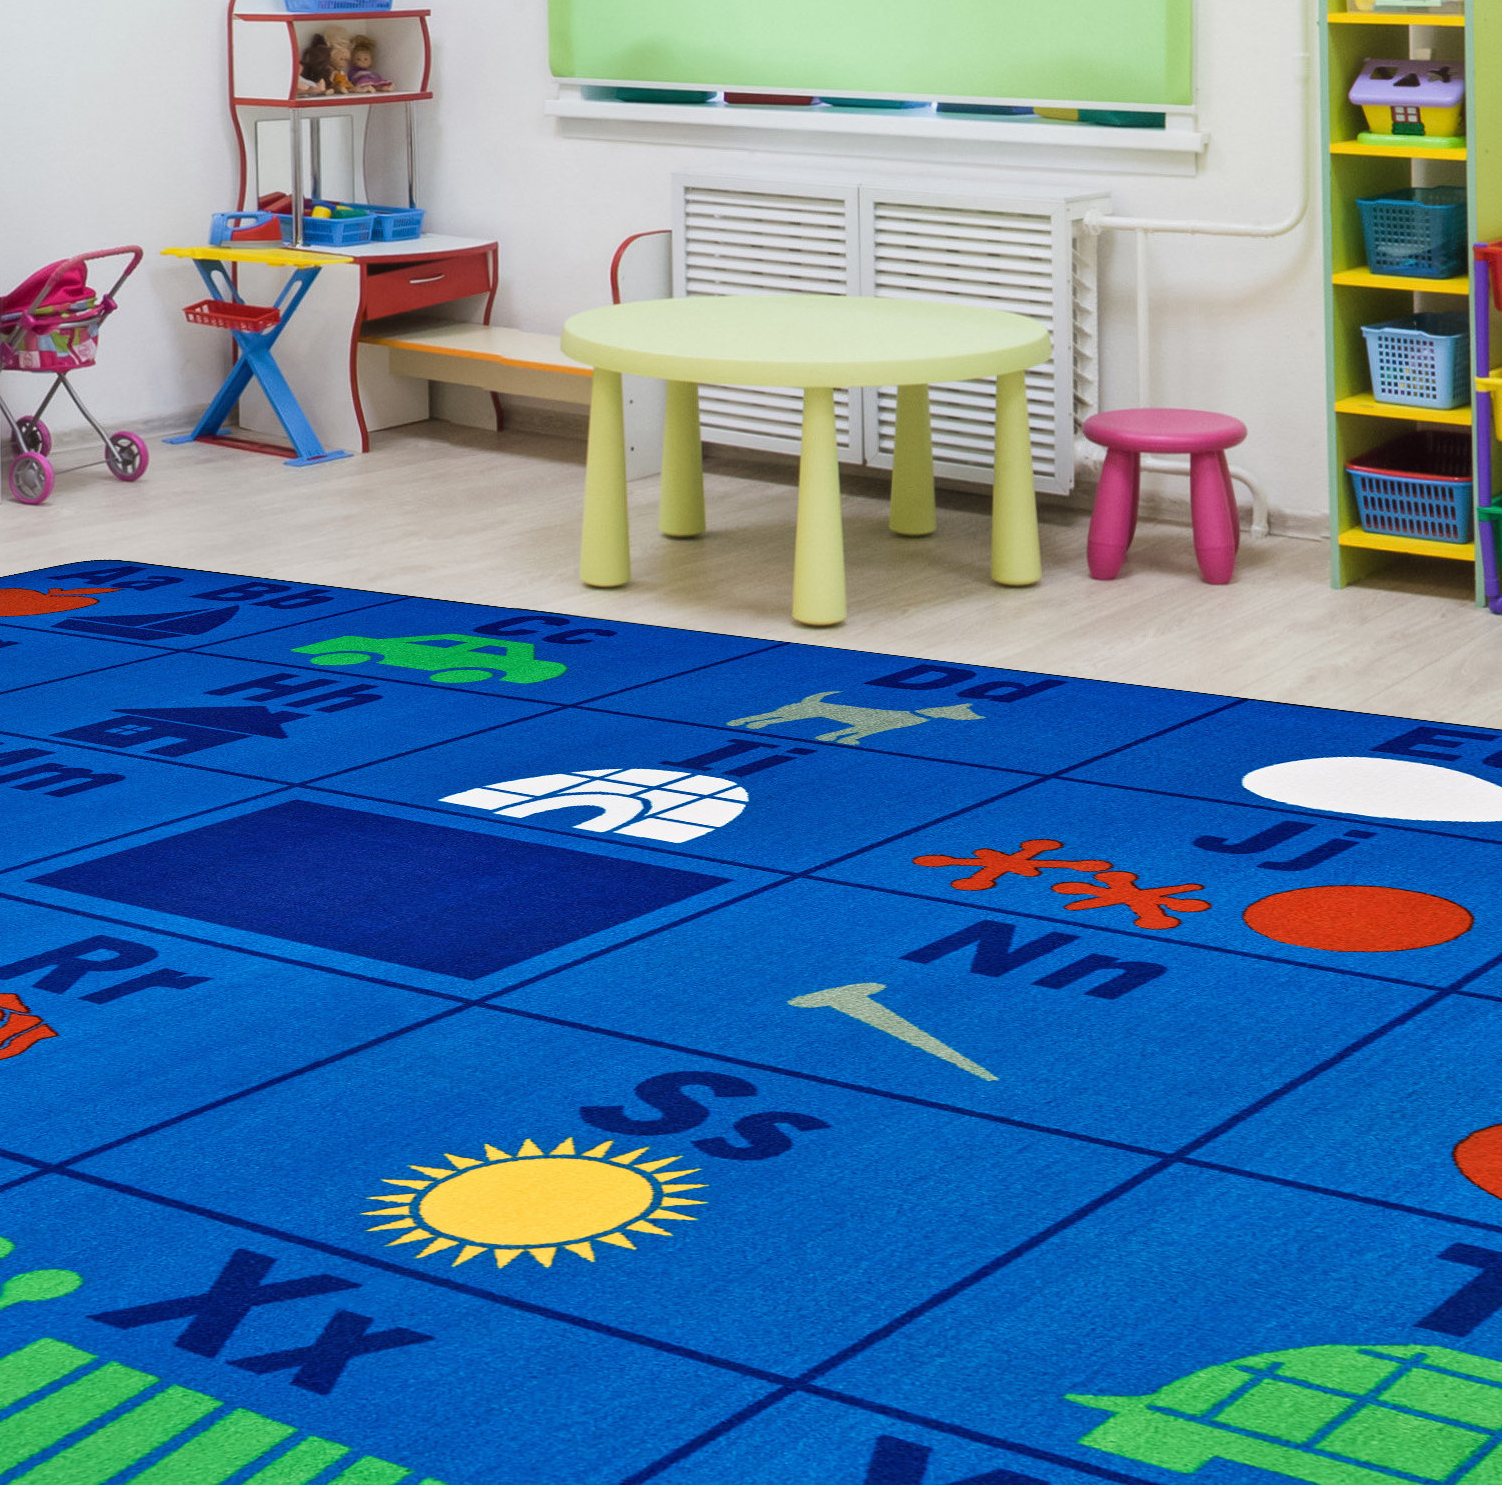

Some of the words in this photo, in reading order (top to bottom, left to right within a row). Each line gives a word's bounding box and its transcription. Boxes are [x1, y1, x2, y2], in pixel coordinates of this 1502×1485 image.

[48, 566, 185, 591] Aa
[188, 581, 335, 610] Bb
[471, 615, 618, 647] Cc
[204, 672, 384, 714] Hh
[862, 662, 1069, 704] Dd
[1191, 820, 1378, 872] Jj
[898, 919, 1168, 1000] Nn
[579, 1070, 832, 1161] Ss
[85, 1248, 435, 1396] Xx
